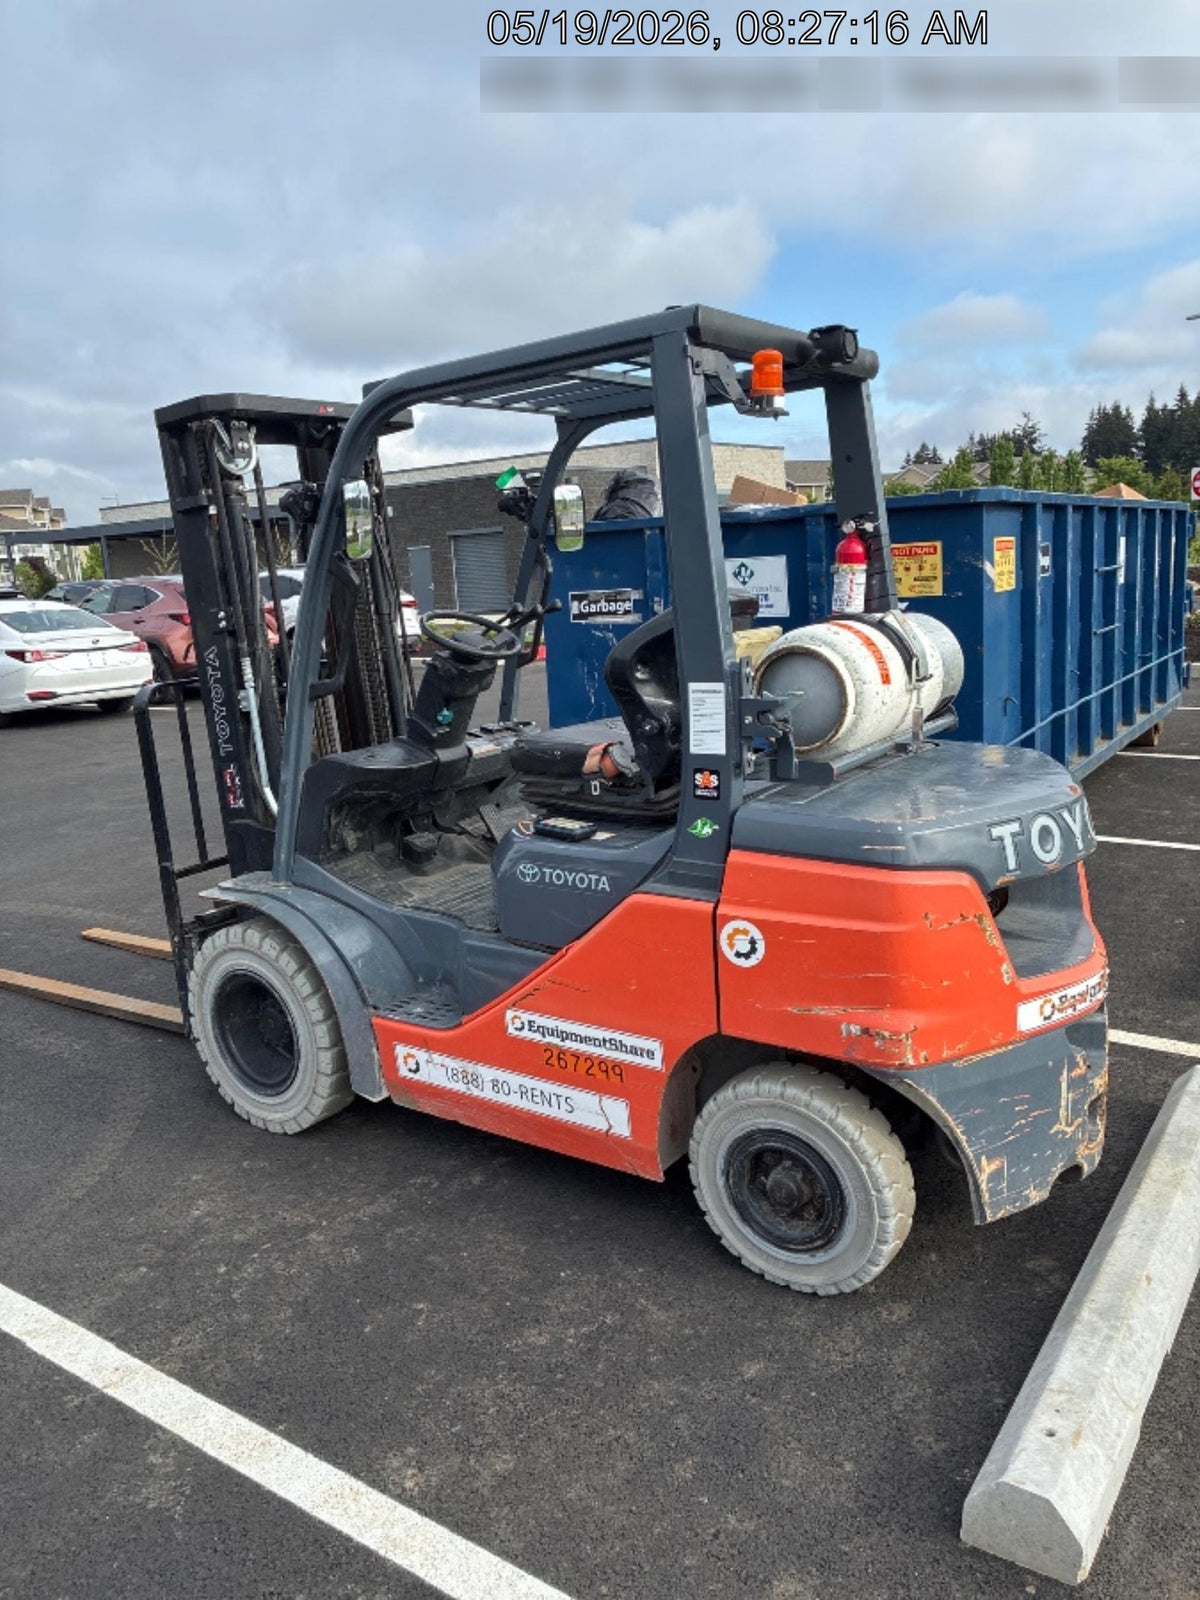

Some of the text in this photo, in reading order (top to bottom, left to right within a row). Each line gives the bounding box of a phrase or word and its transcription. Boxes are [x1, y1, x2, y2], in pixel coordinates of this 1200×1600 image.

[581, 600, 631, 614] Garbage
[204, 646, 233, 757] TOYOTA
[543, 867, 610, 893] TOYOTA
[527, 1019, 656, 1061] EquipmentShare
[543, 1048, 625, 1084] 267299
